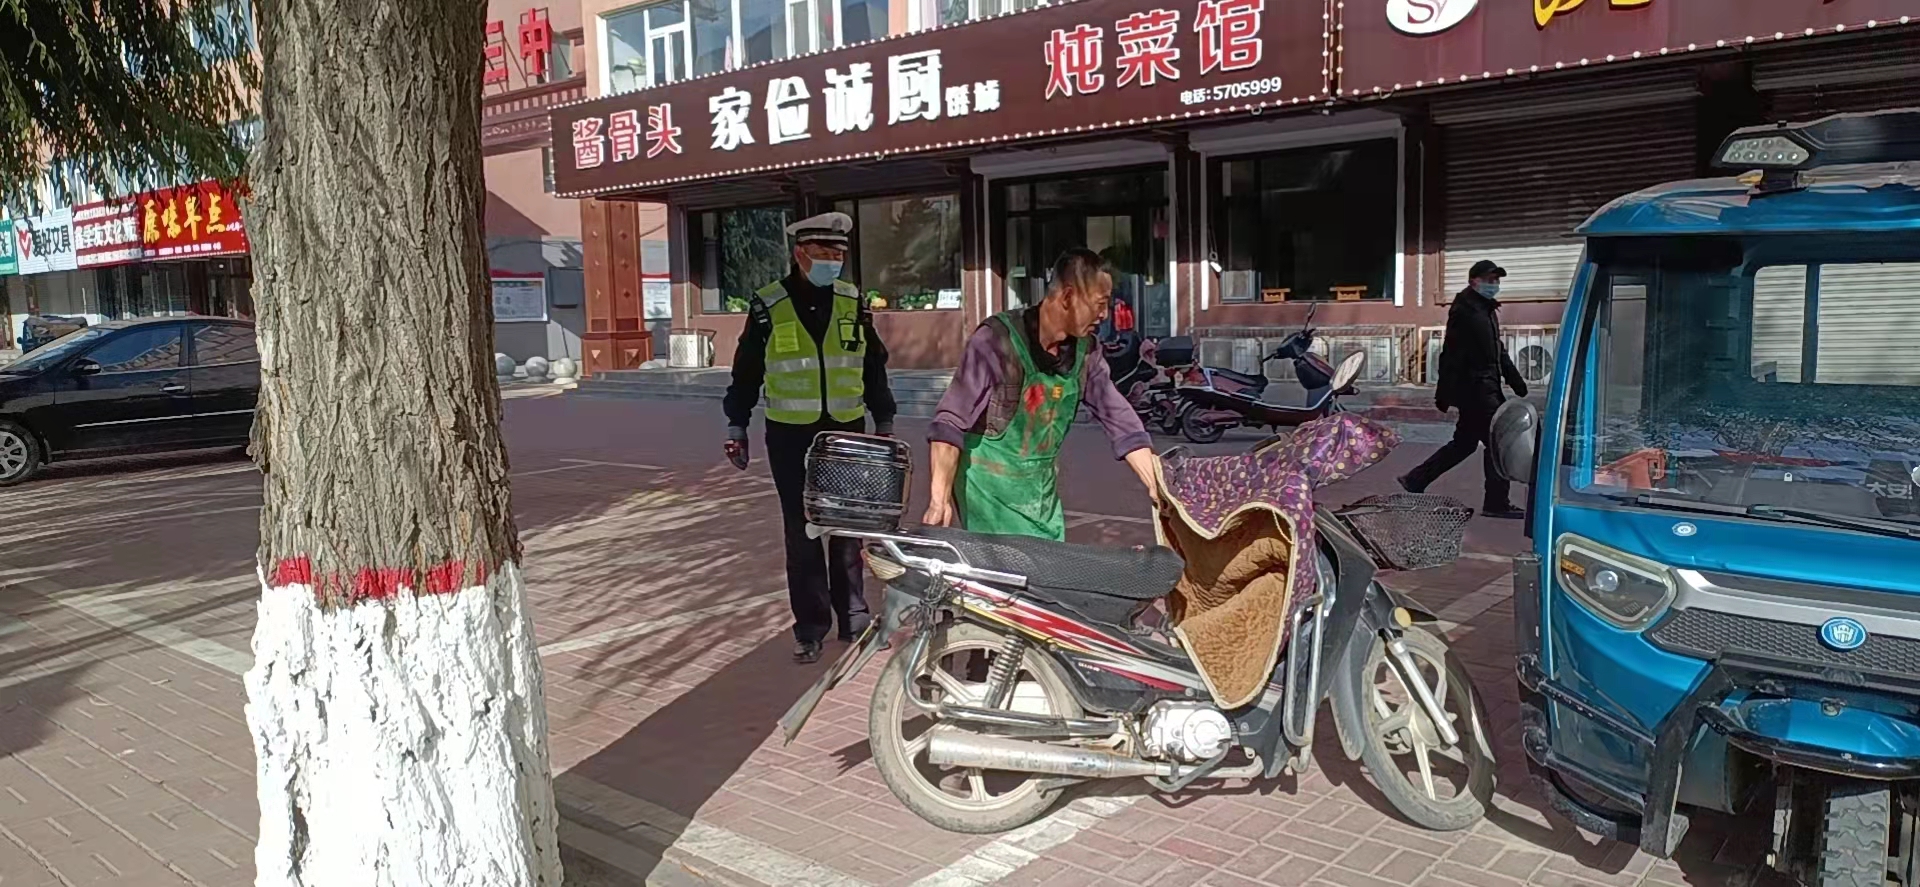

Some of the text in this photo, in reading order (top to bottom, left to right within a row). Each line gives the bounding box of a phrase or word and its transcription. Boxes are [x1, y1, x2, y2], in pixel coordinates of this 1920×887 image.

[1044, 0, 1265, 100] 炖菜馆
[571, 103, 683, 169] 酱骨头
